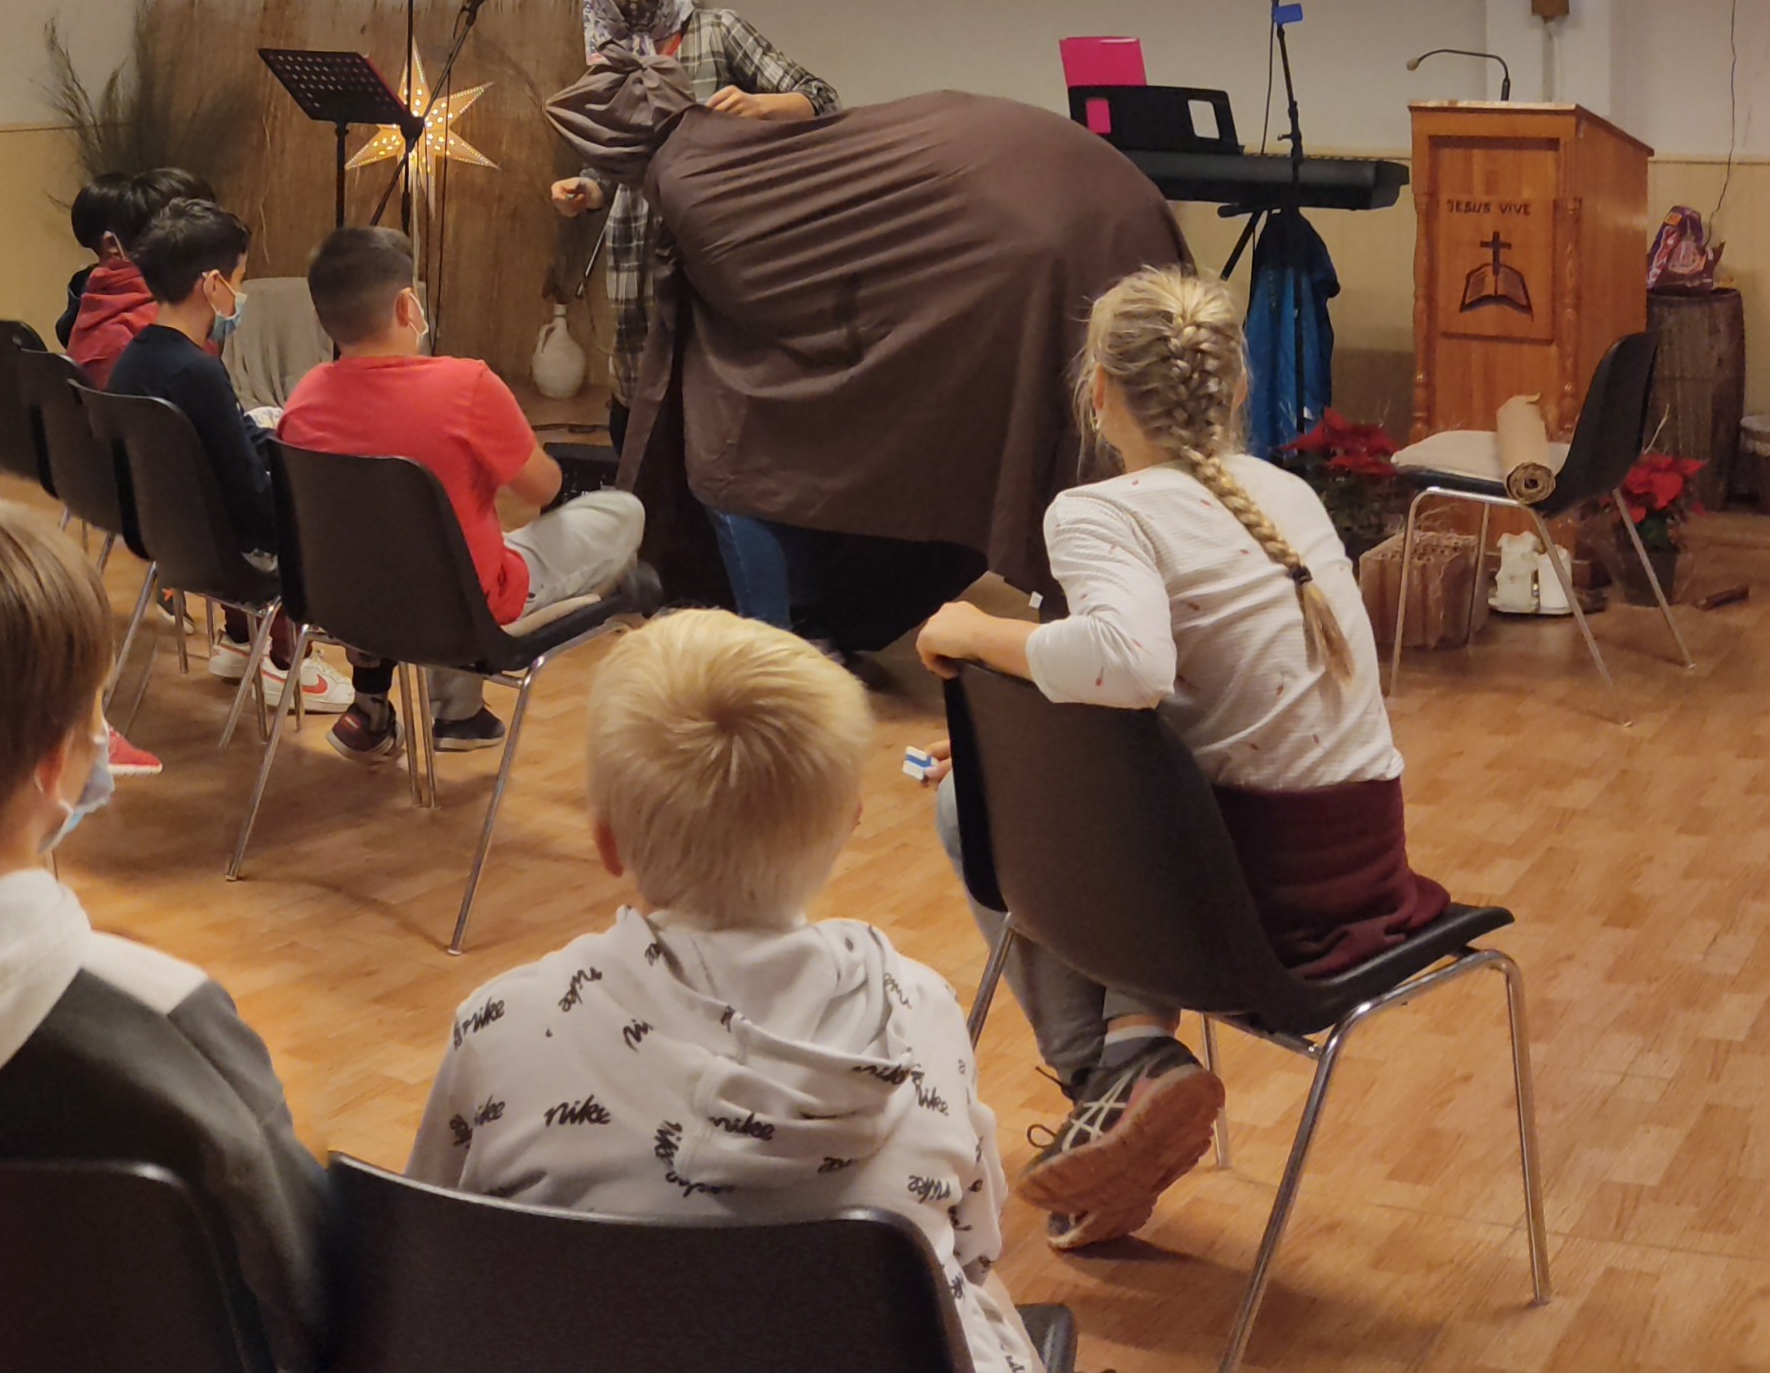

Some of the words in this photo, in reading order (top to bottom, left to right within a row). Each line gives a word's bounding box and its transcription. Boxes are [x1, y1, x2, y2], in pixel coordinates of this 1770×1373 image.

[1447, 199, 1492, 214] JESUS
[1499, 202, 1532, 217] VIVE
[543, 1093, 613, 1128] nike
[707, 1111, 776, 1142] nike
